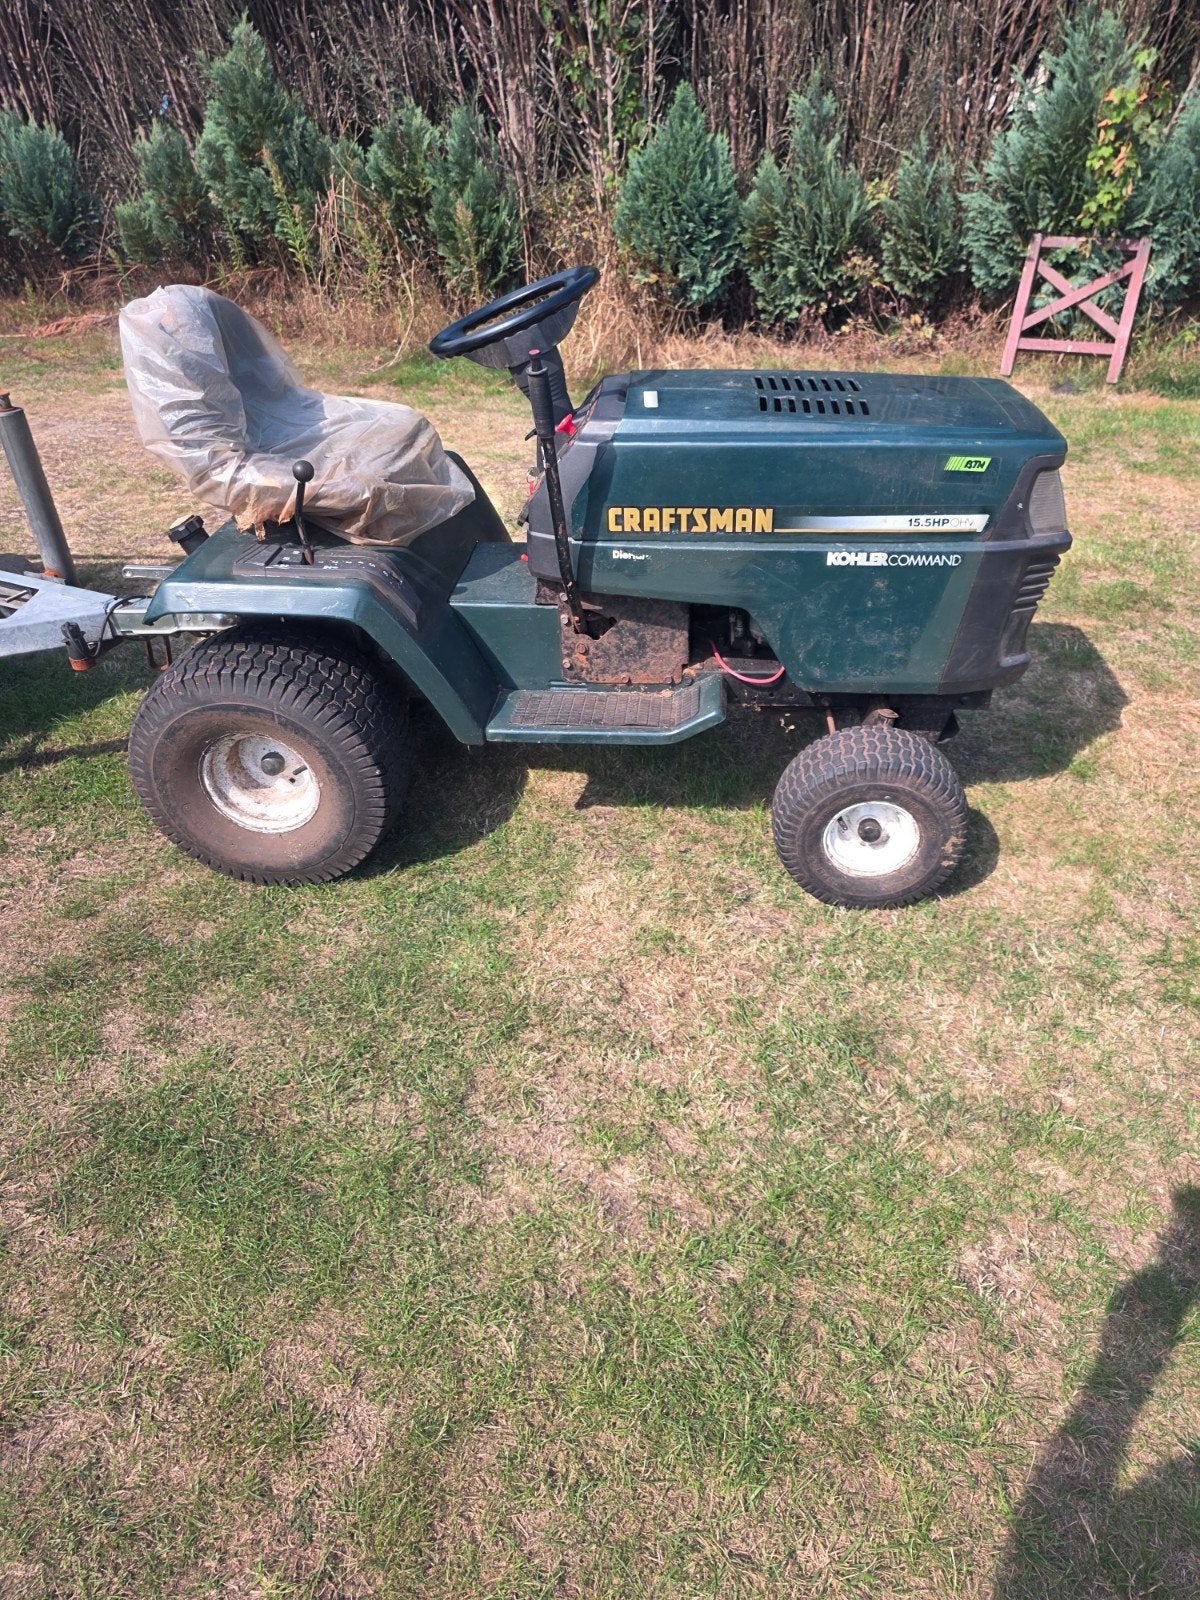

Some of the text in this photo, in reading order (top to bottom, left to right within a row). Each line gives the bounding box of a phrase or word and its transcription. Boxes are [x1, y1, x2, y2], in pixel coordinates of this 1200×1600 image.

[607, 507, 774, 533] CRAFTSMAN
[826, 551, 962, 566] KOHLER COMMAND
